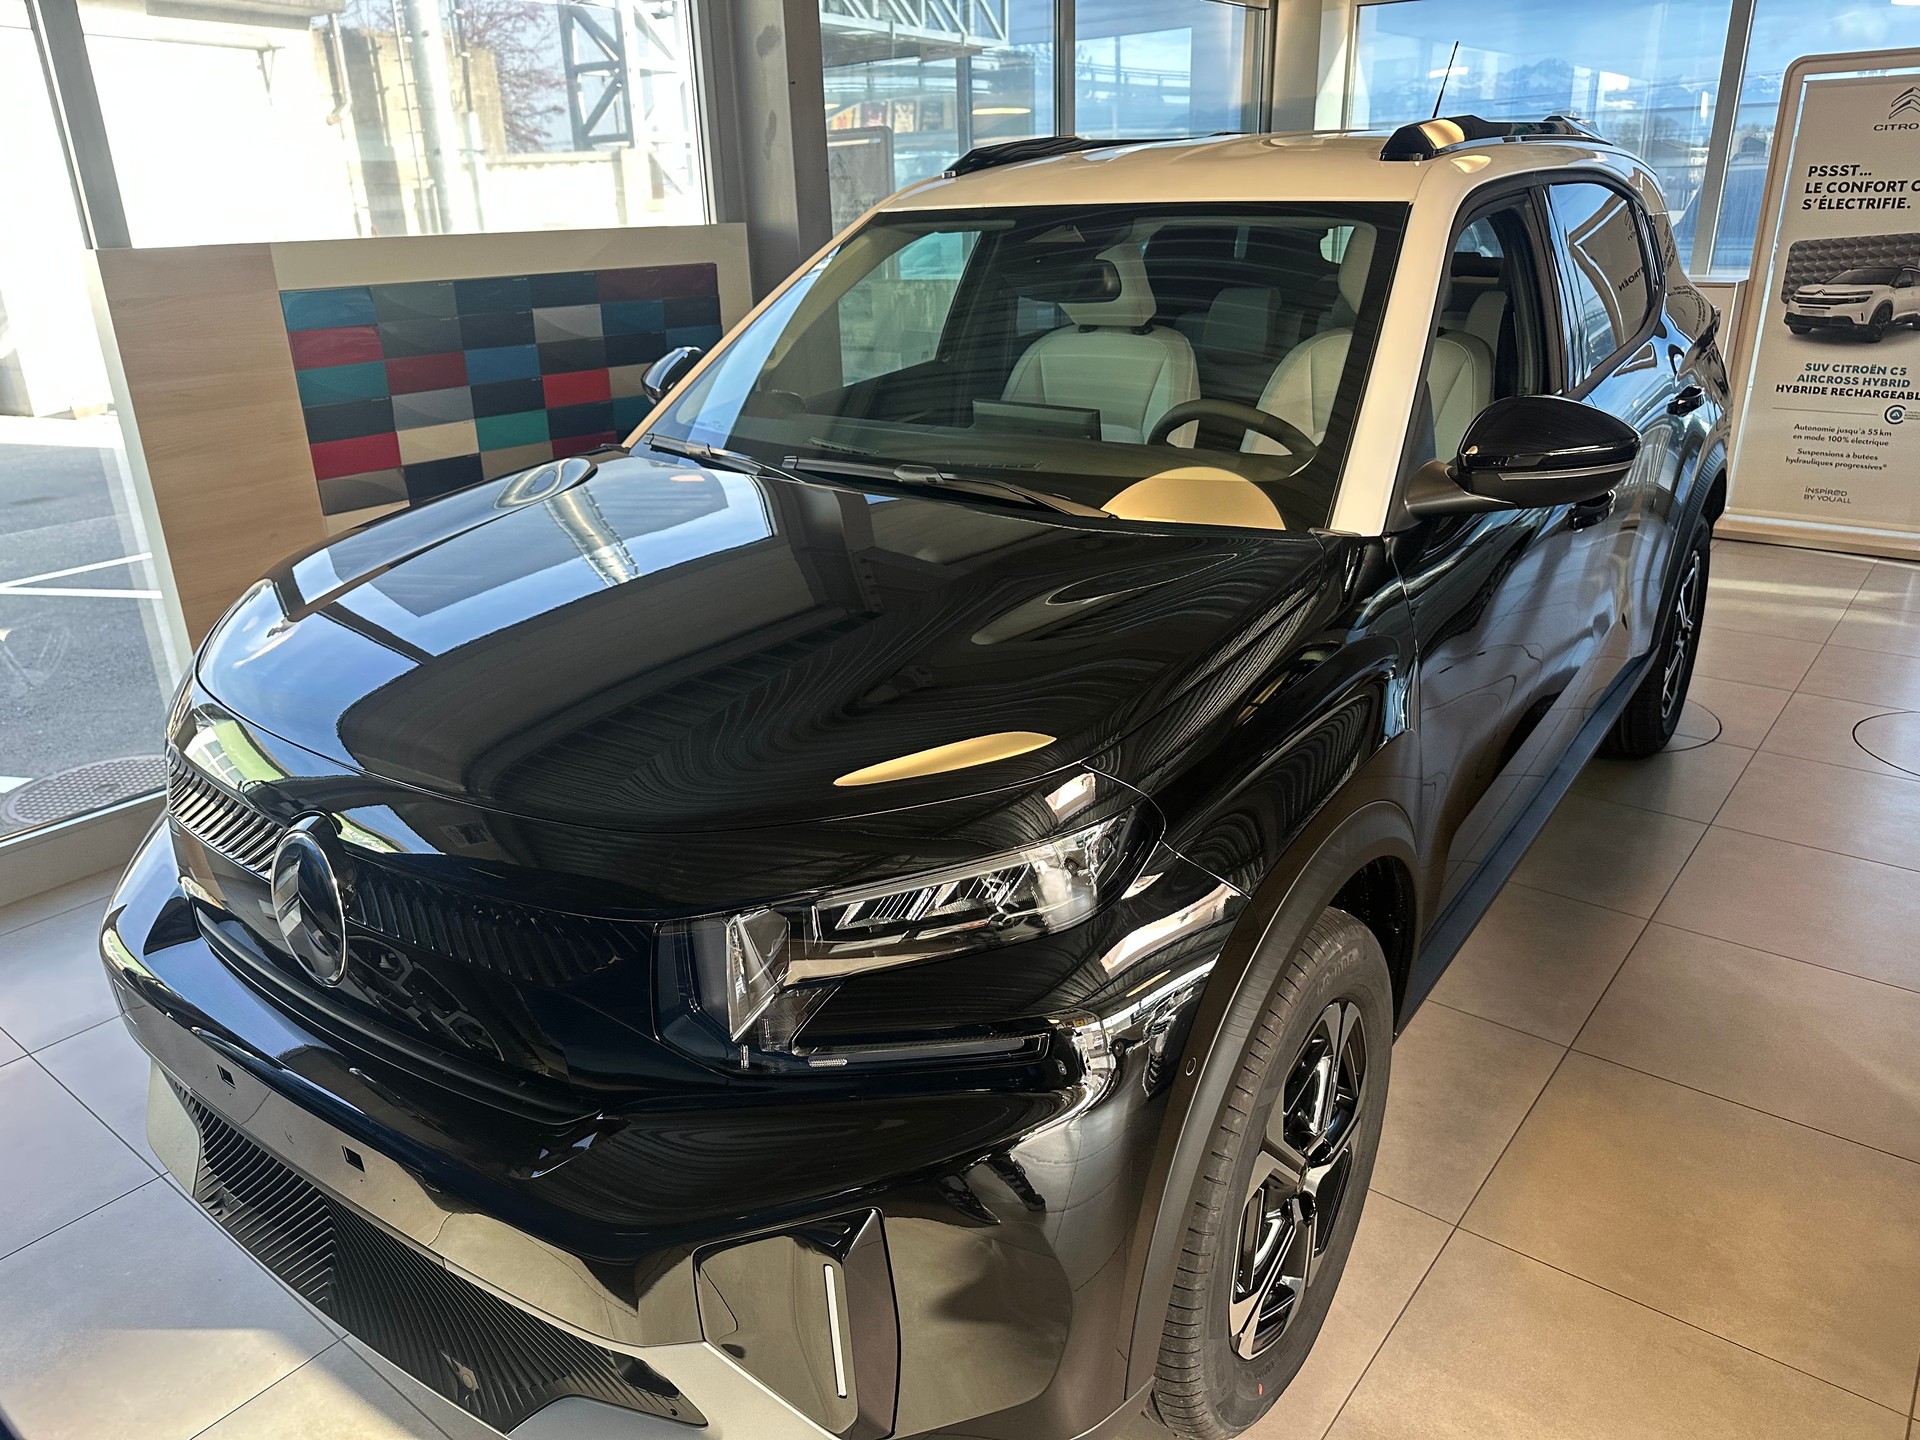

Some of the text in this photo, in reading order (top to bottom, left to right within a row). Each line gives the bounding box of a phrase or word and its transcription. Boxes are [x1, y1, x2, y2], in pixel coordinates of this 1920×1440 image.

[1873, 122, 1919, 131] CITRO
[1808, 164, 1872, 177] PSSST...
[1805, 181, 1823, 194] LE
[1826, 180, 1908, 194] CONFORT
[1802, 195, 1911, 210] S'ÉLECTRIFIE.
[1805, 363, 1830, 372] SUV
[1832, 363, 1887, 375] CITROËN
[1797, 374, 1911, 388] AIRCROSS HYBRID
[1776, 384, 1920, 400] HYBRIDE RECHARGEABL
[1793, 423, 1892, 437] Autonomie jusqu'à 55 km
[1804, 434, 1825, 442] mode
[1828, 435, 1850, 443] 100%
[1850, 437, 1889, 447] électrique
[1797, 447, 1844, 458] Suspensions
[1852, 451, 1878, 460] butées
[1785, 456, 1833, 467] hydrauliques
